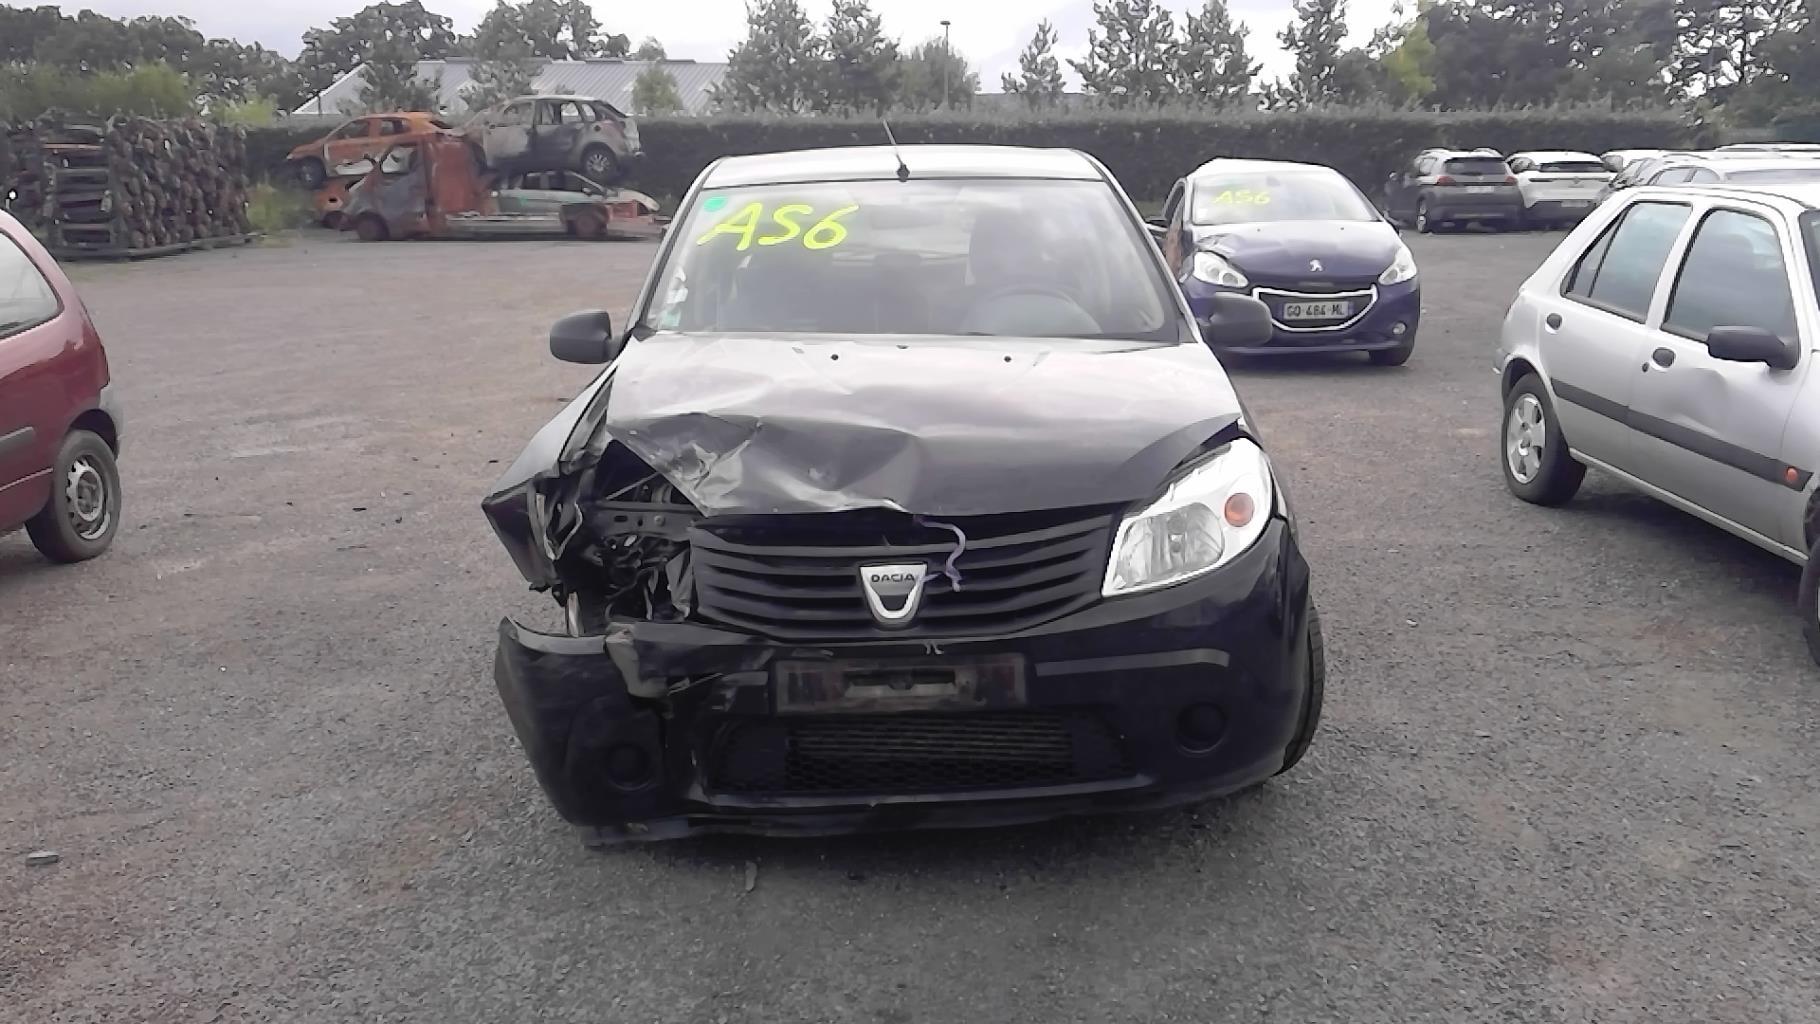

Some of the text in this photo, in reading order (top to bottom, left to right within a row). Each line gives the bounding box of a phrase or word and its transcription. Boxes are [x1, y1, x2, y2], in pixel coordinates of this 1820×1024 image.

[1213, 189, 1270, 205] AS6
[697, 202, 859, 250] AS6
[871, 573, 915, 583] DACIA
